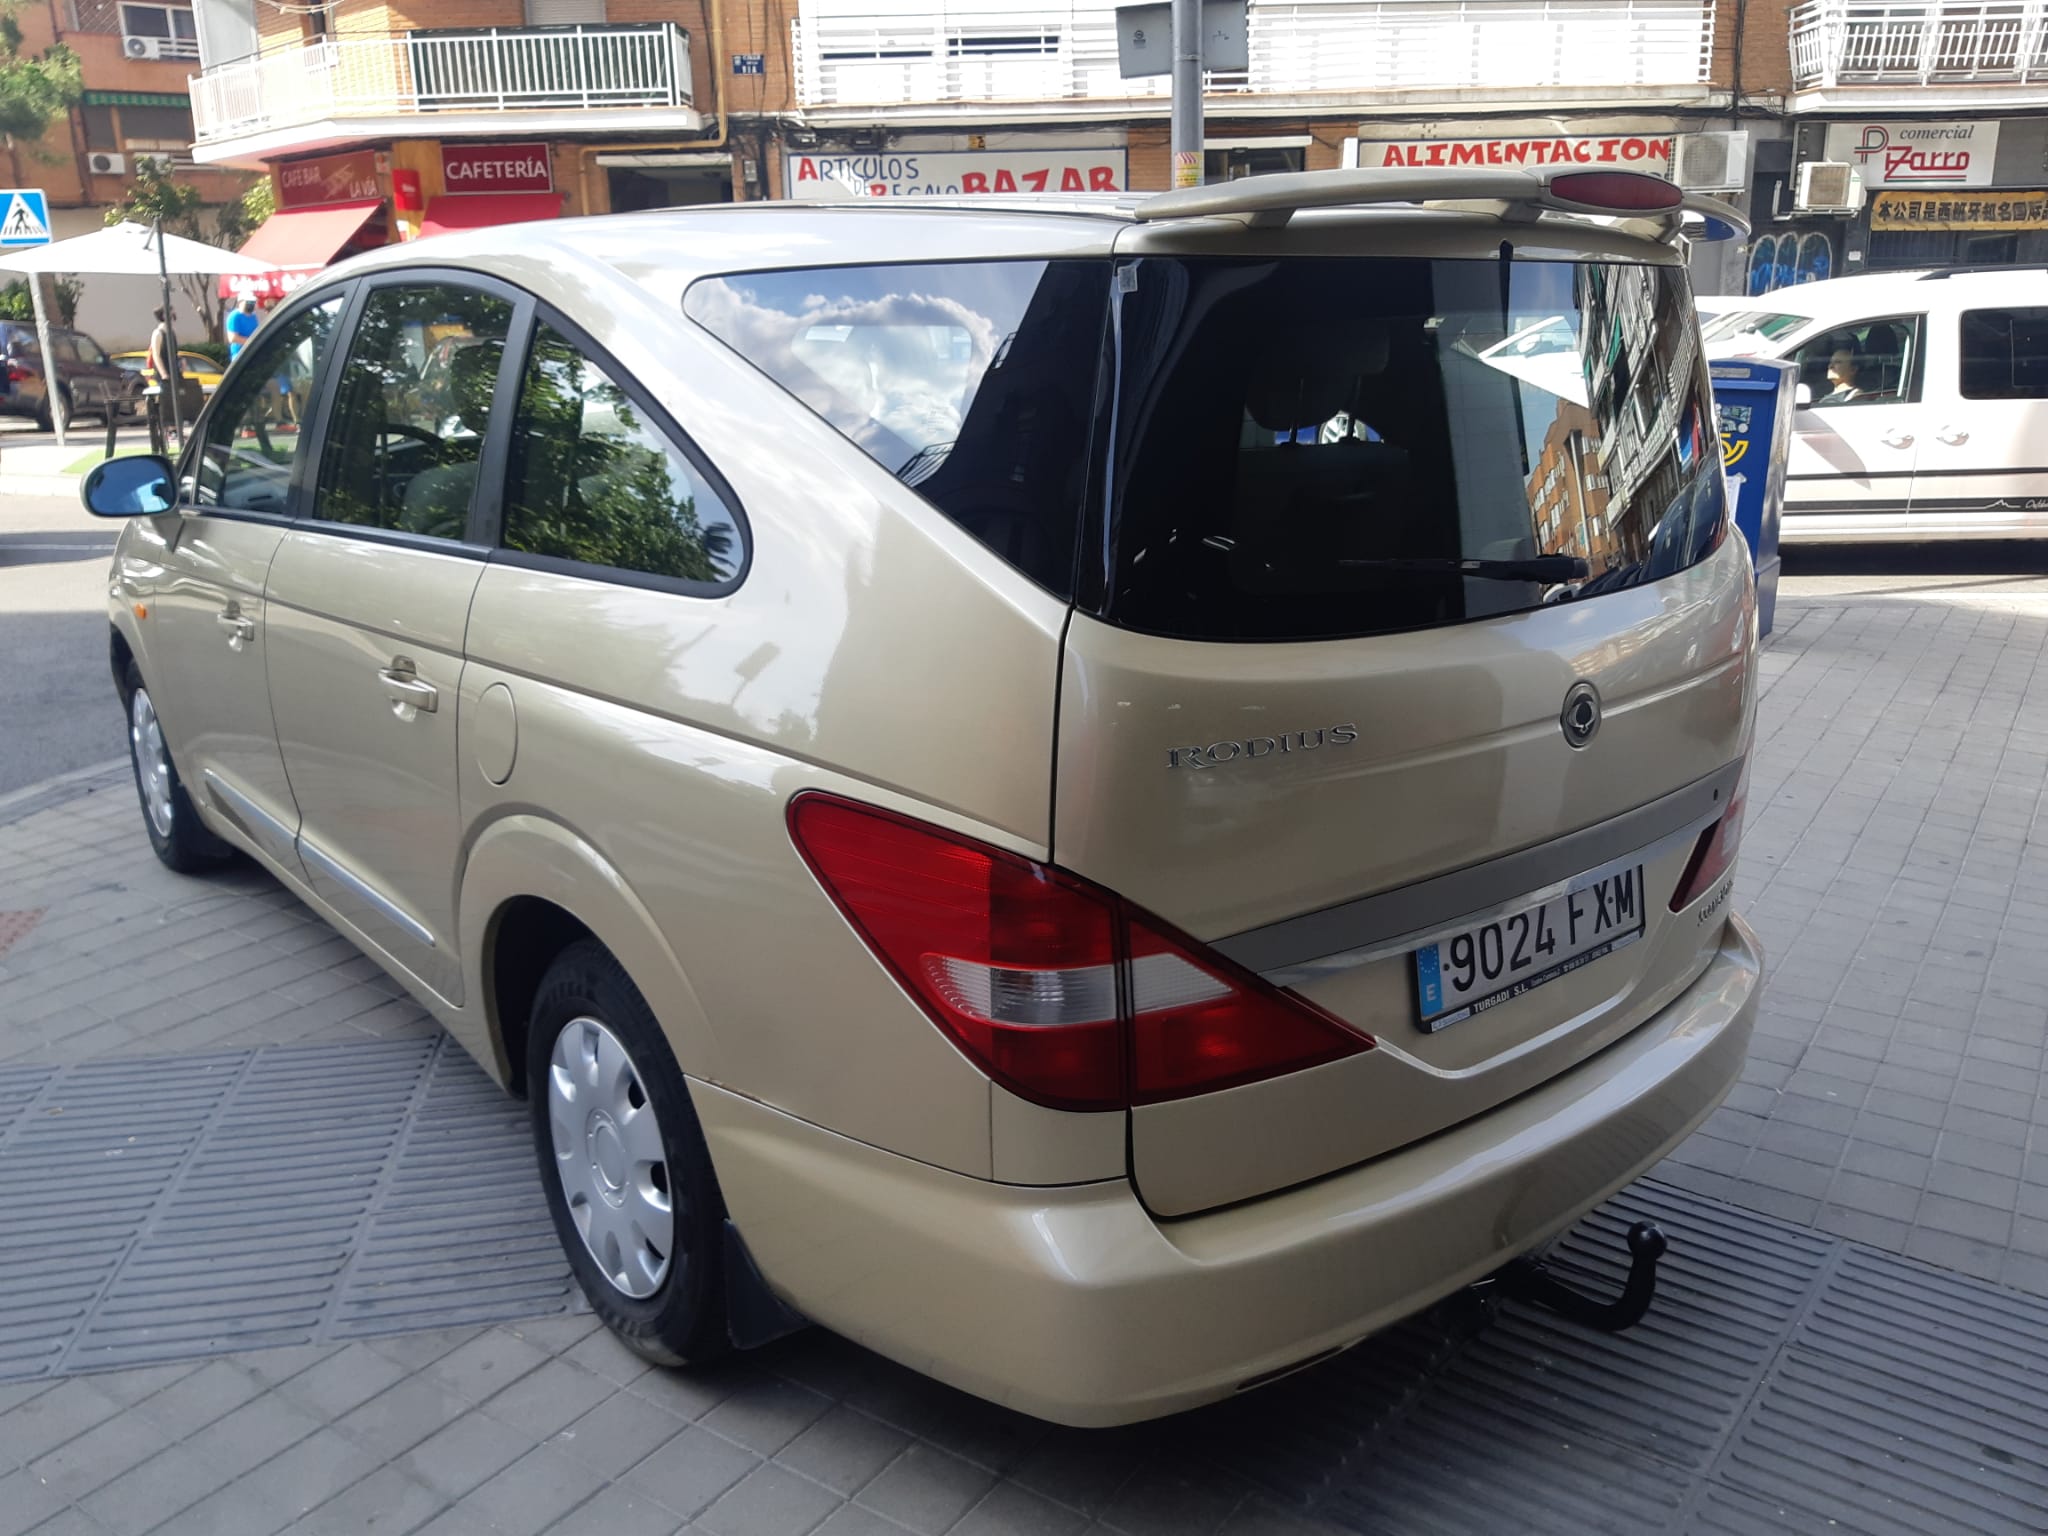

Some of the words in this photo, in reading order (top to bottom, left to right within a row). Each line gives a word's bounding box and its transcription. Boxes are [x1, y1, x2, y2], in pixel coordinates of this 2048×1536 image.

[1899, 124, 1976, 140] comercial
[1381, 137, 1670, 168] ALIMENTACION
[445, 156, 548, 180] CAFETERÍA
[961, 166, 1121, 193] BAZAR
[1166, 722, 1359, 770] RODIUS
[1449, 904, 1556, 993] 9024
[1426, 983, 1438, 1002] E
[1473, 990, 1510, 1013] TURGADI
[1513, 983, 1530, 996] S.L.
